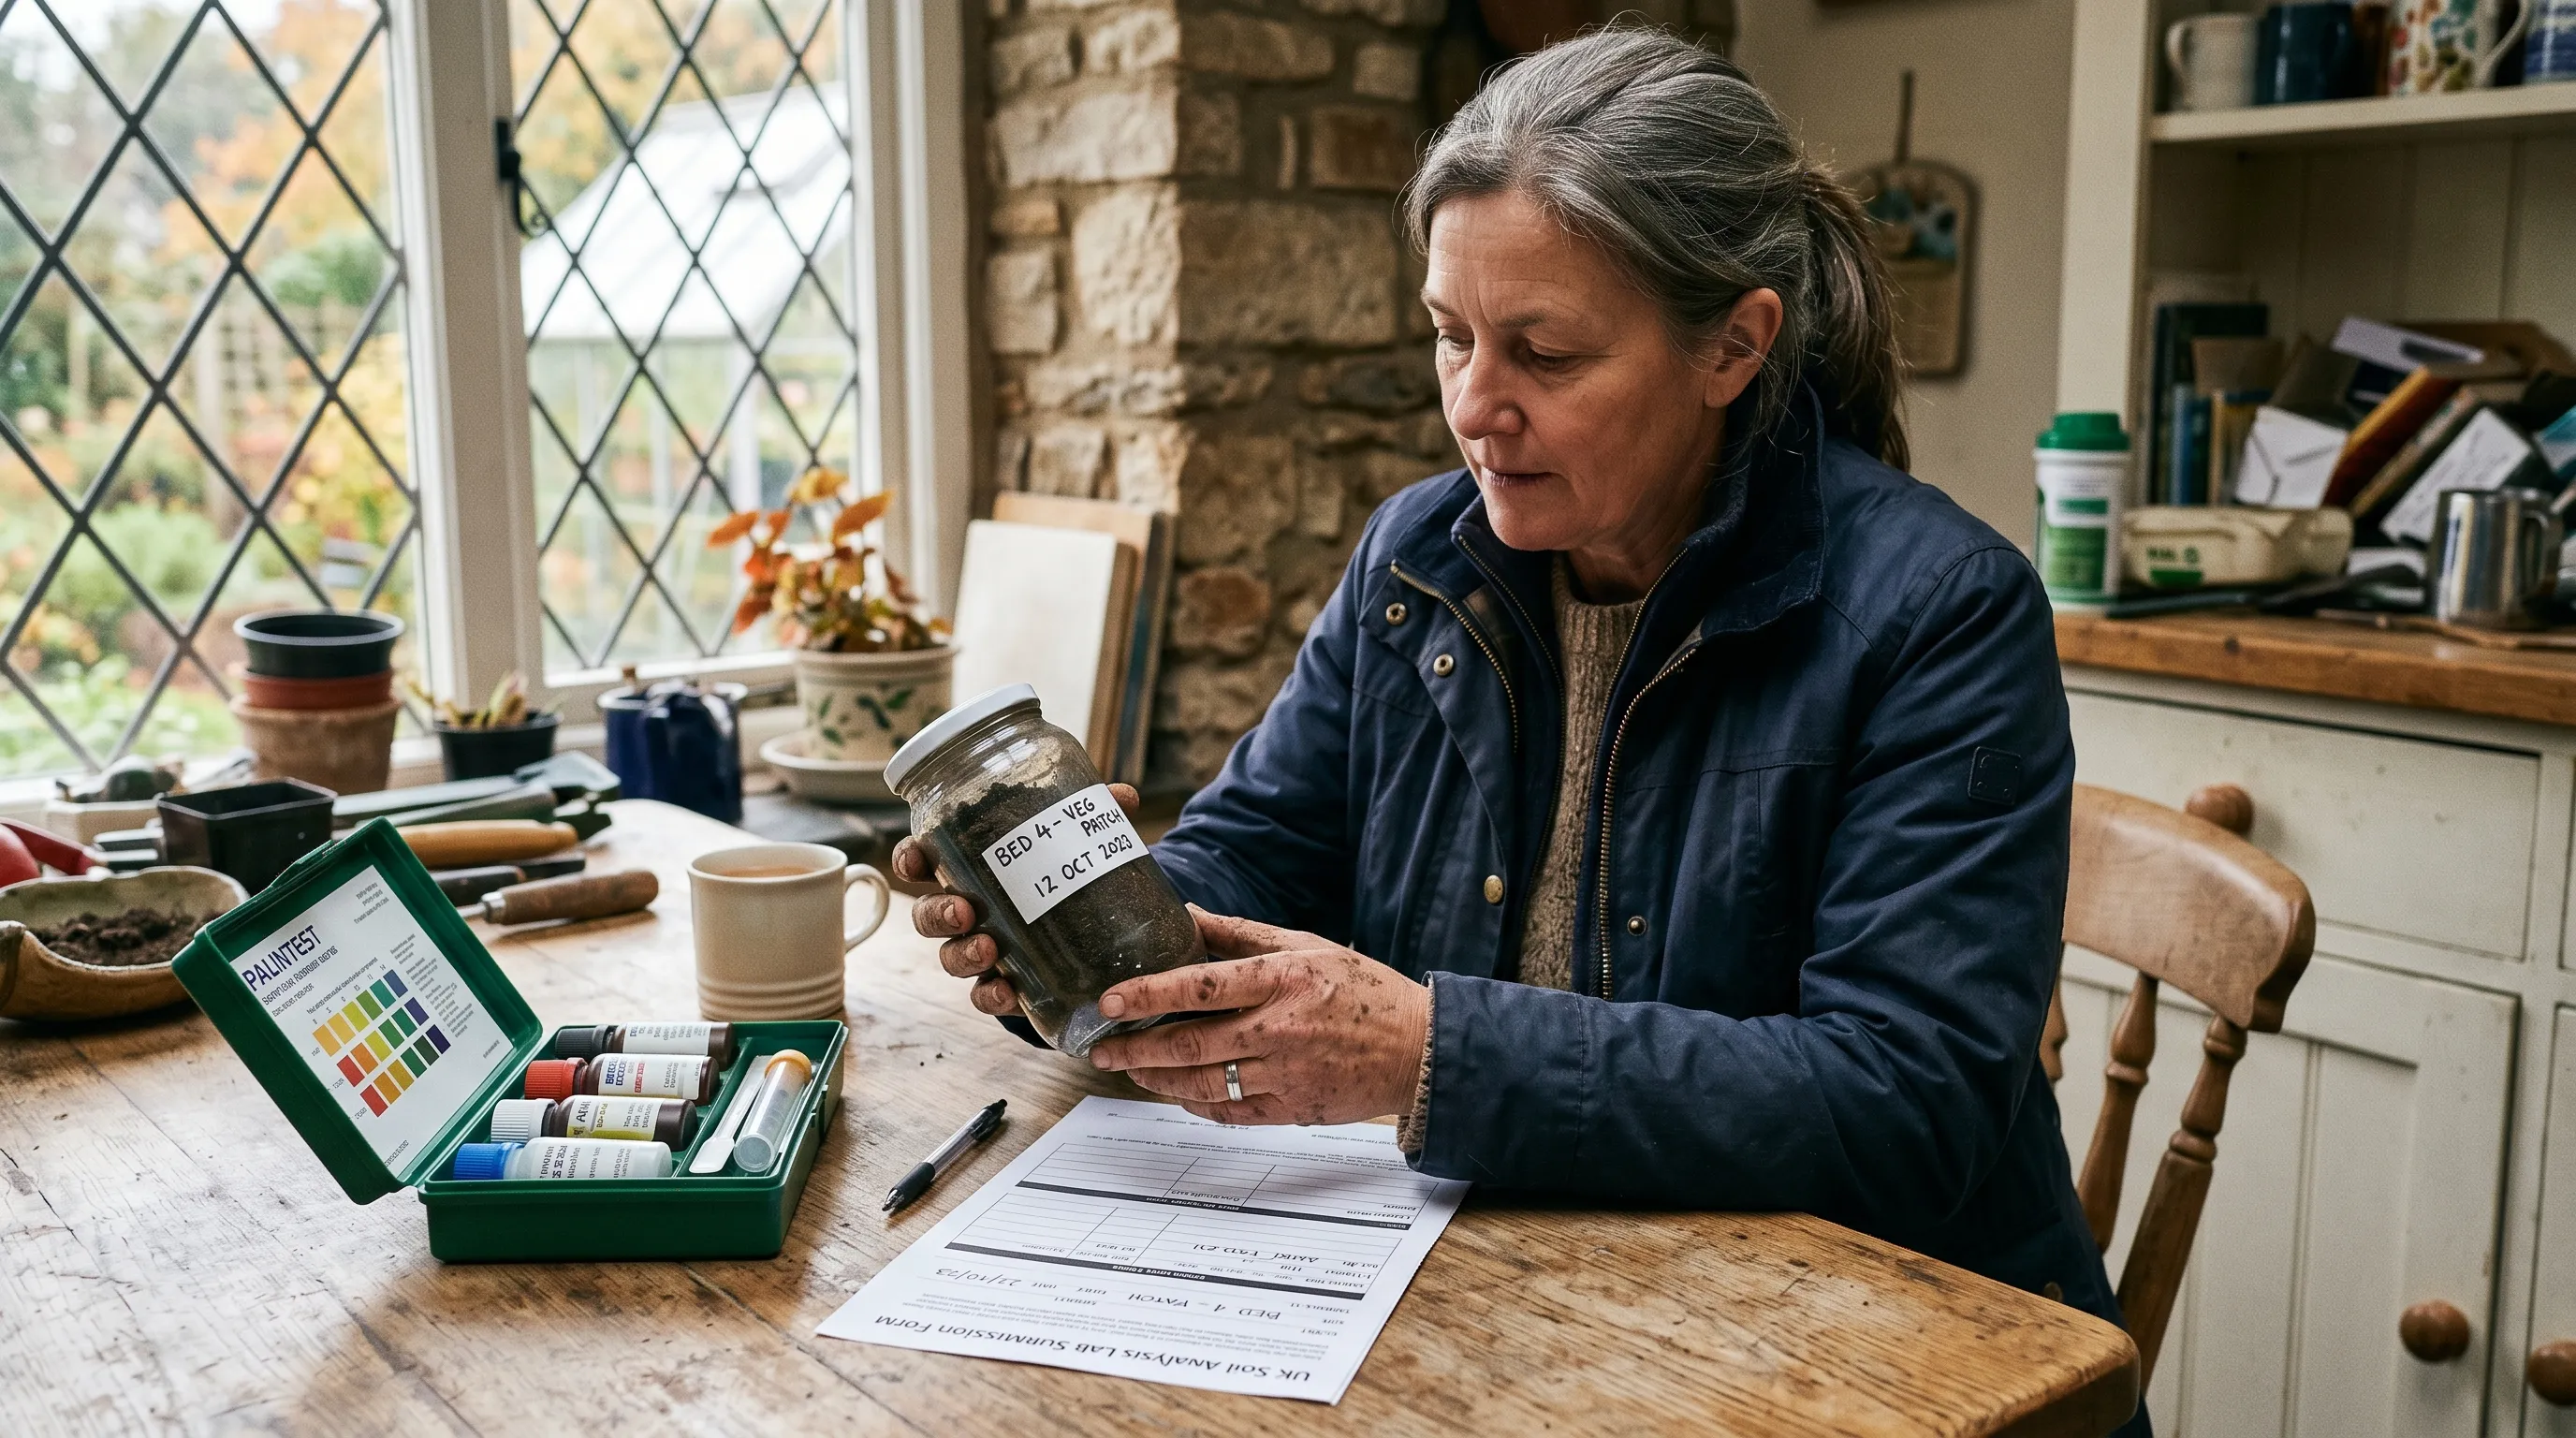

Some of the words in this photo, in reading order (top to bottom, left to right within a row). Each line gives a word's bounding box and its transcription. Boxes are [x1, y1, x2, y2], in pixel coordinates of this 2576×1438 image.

[994, 835, 1032, 867] BED
[1034, 823, 1052, 839] 4
[1062, 798, 1095, 820] VEG
[1034, 875, 1059, 898] 12
[1061, 851, 1094, 880] OCT
[1098, 834, 1133, 860] 2023
[242, 925, 321, 991] PALINTEST
[1237, 1308, 1281, 1320] BED
[1226, 1362, 1272, 1377] Soil
[1279, 1369, 1311, 1382] UK
